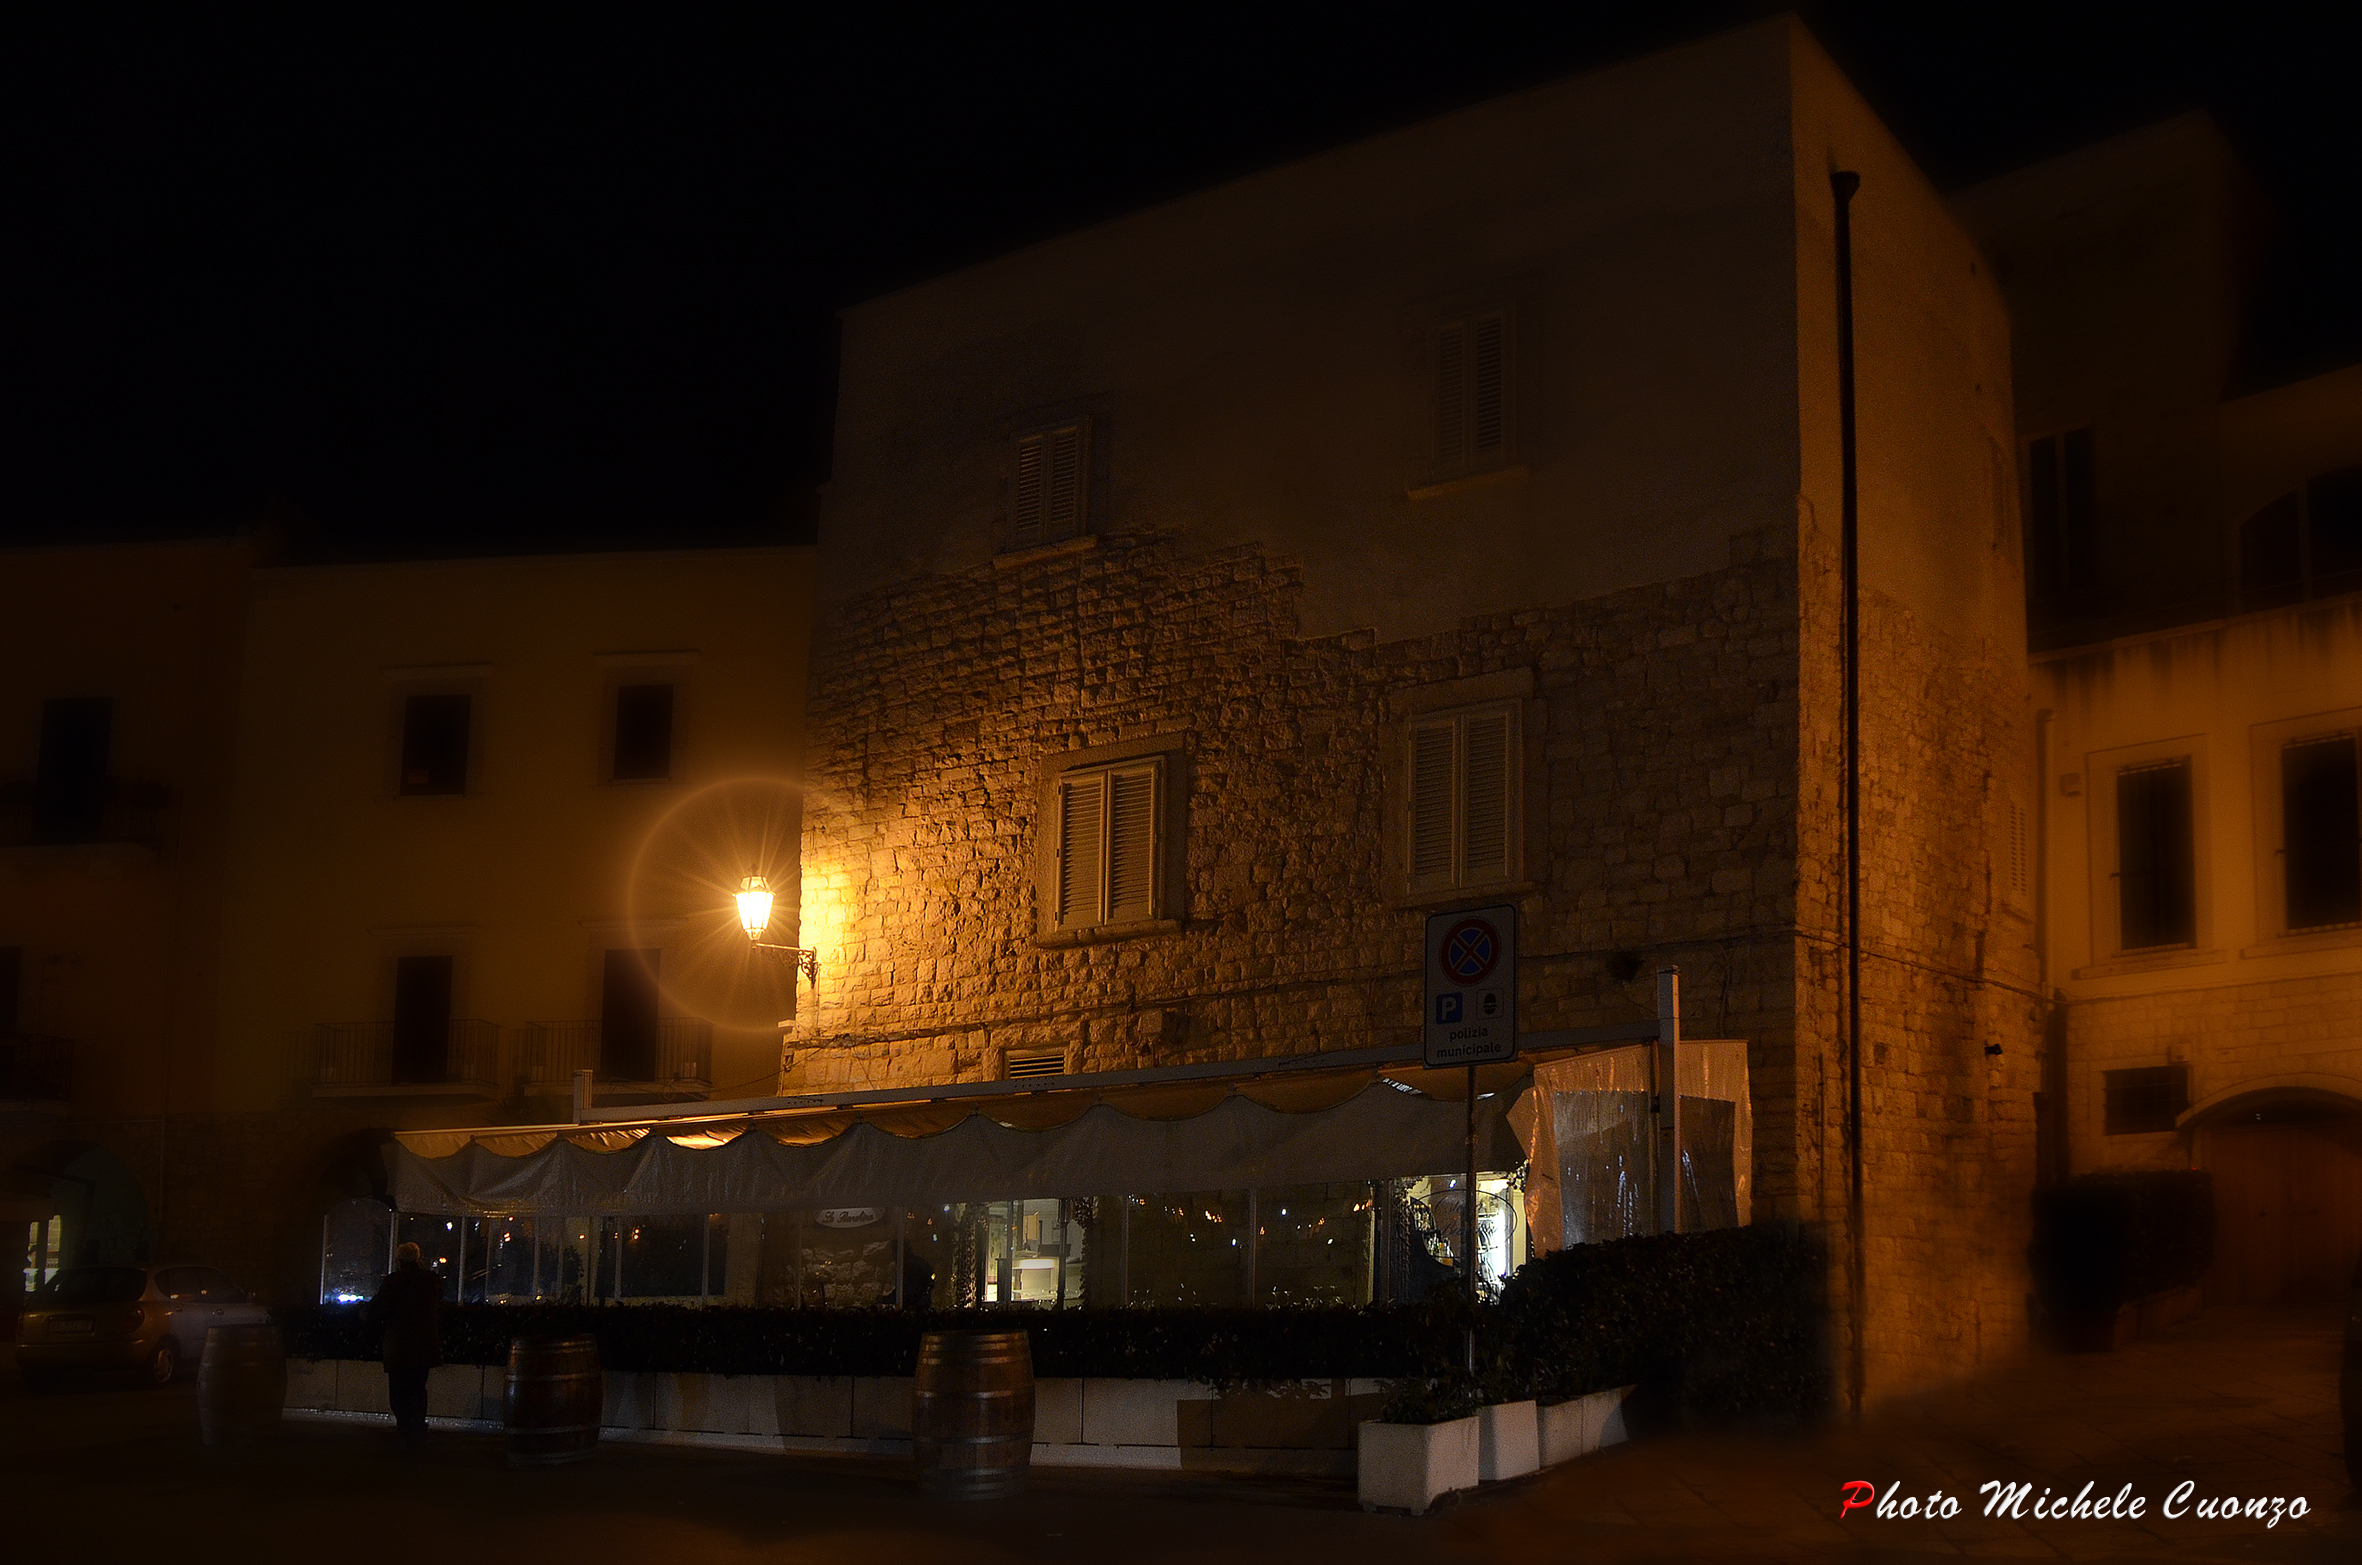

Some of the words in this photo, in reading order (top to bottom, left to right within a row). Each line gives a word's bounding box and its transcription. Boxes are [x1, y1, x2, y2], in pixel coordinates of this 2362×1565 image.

[1441, 995, 1457, 1021] P
[1449, 1026, 1489, 1042] polizia
[1436, 1041, 1502, 1058] municipale
